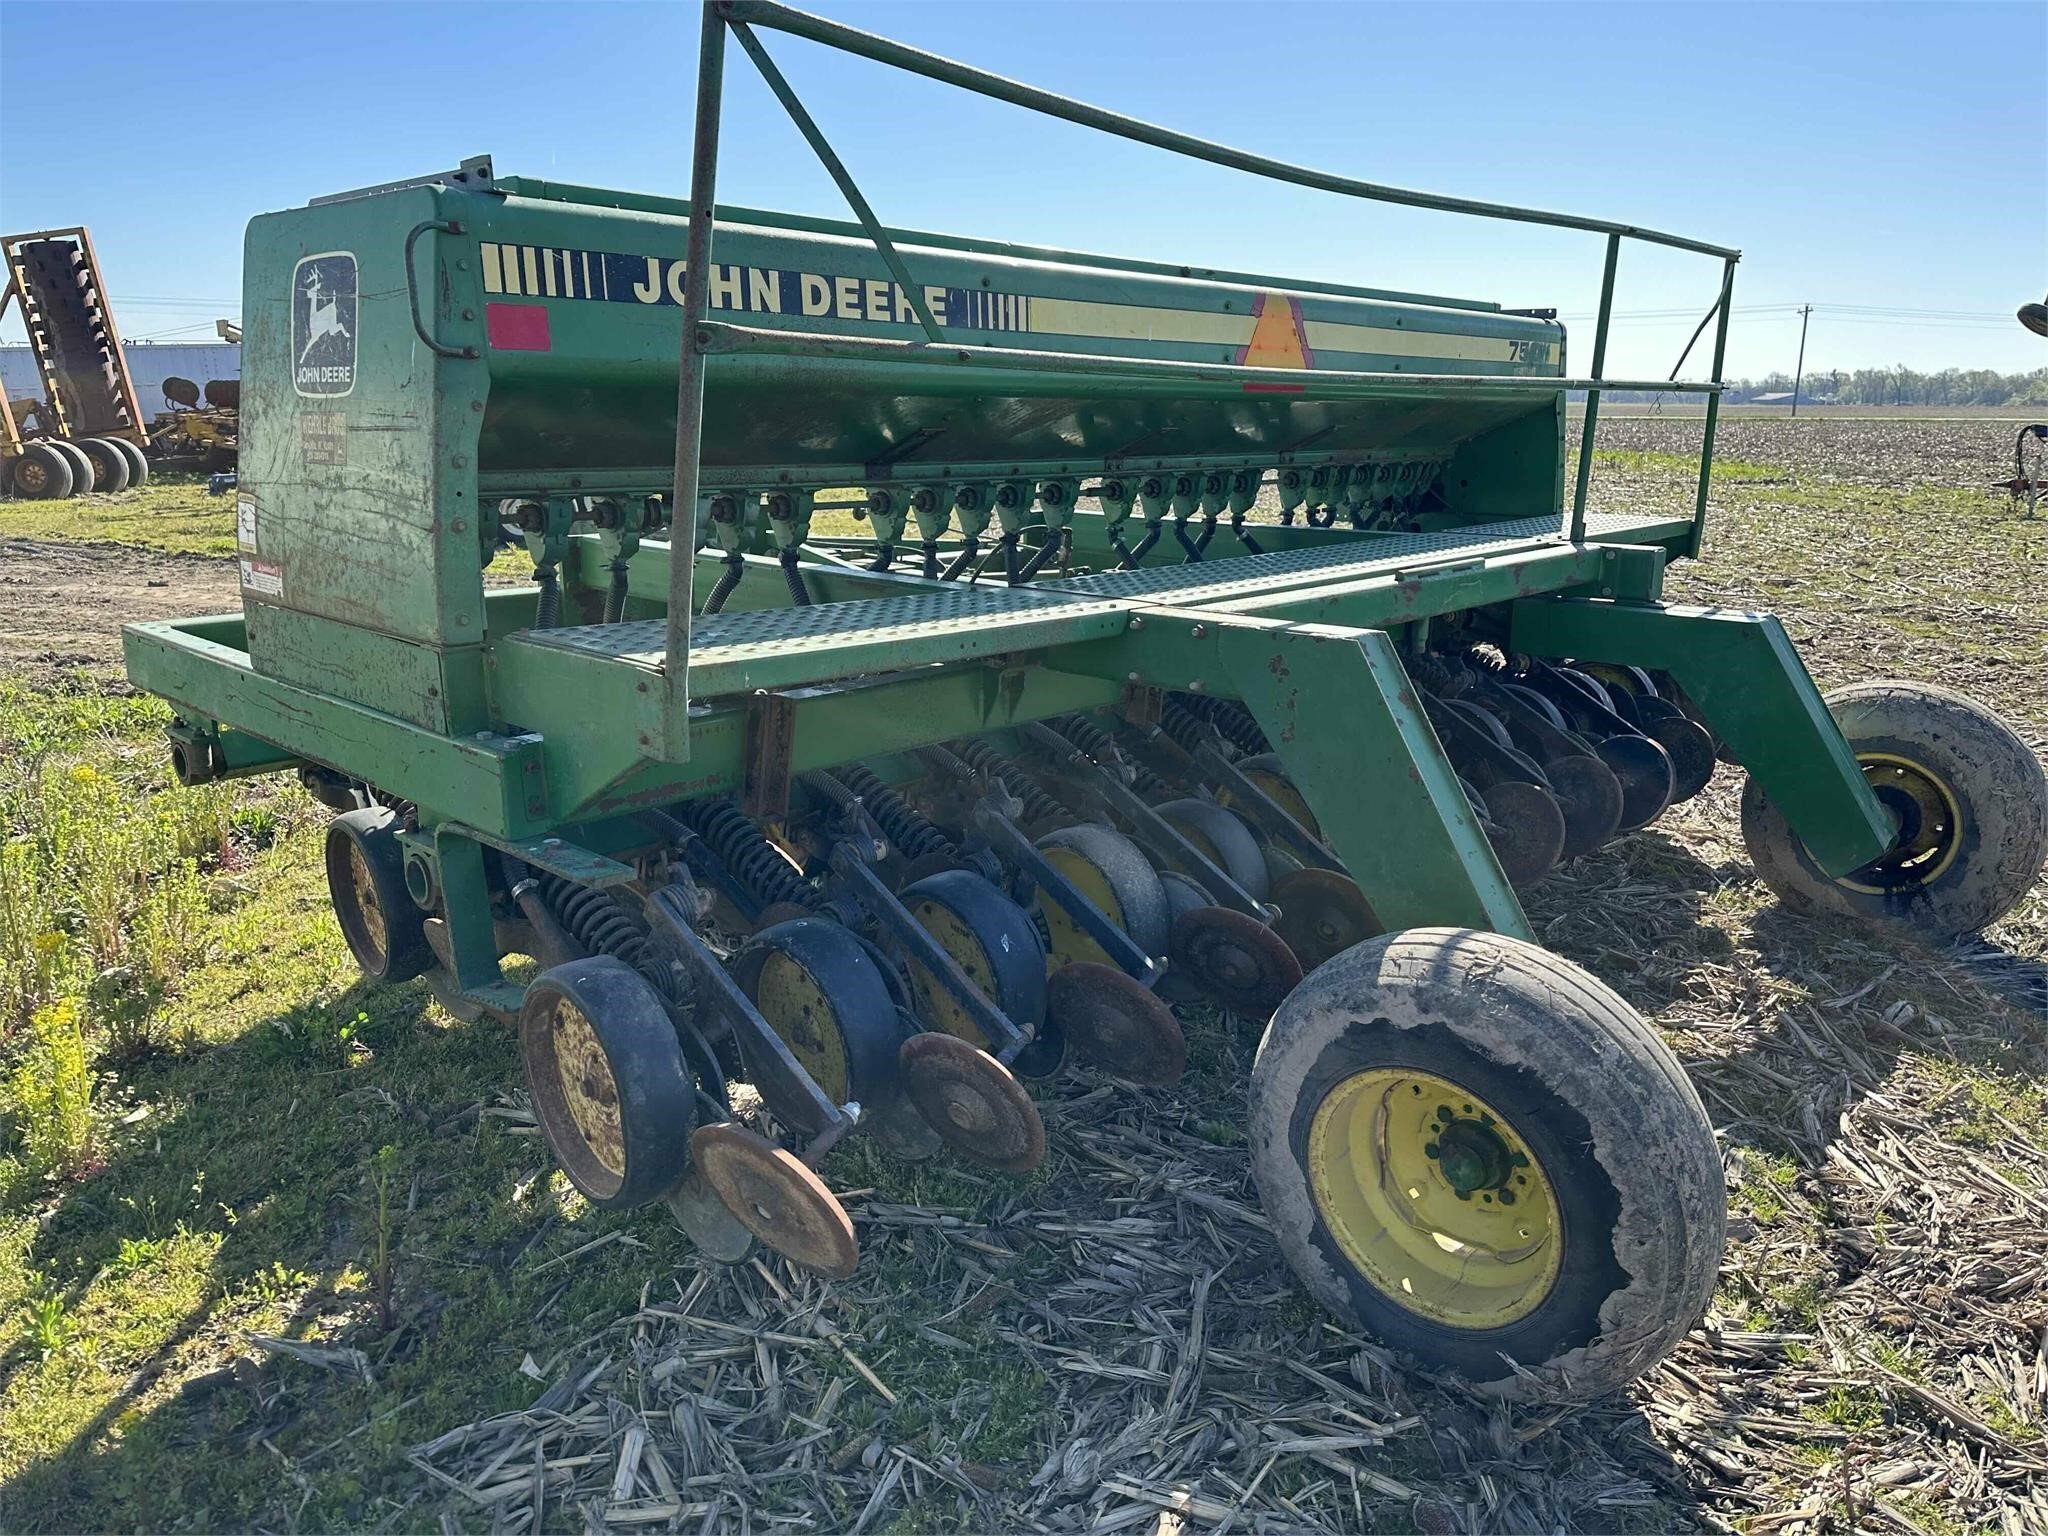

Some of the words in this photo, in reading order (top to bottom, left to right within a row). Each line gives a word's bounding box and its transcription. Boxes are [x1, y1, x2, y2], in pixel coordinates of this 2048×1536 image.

[800, 273, 947, 326] DEERE
[297, 367, 320, 383] JOHN
[321, 366, 351, 382] DEERE
